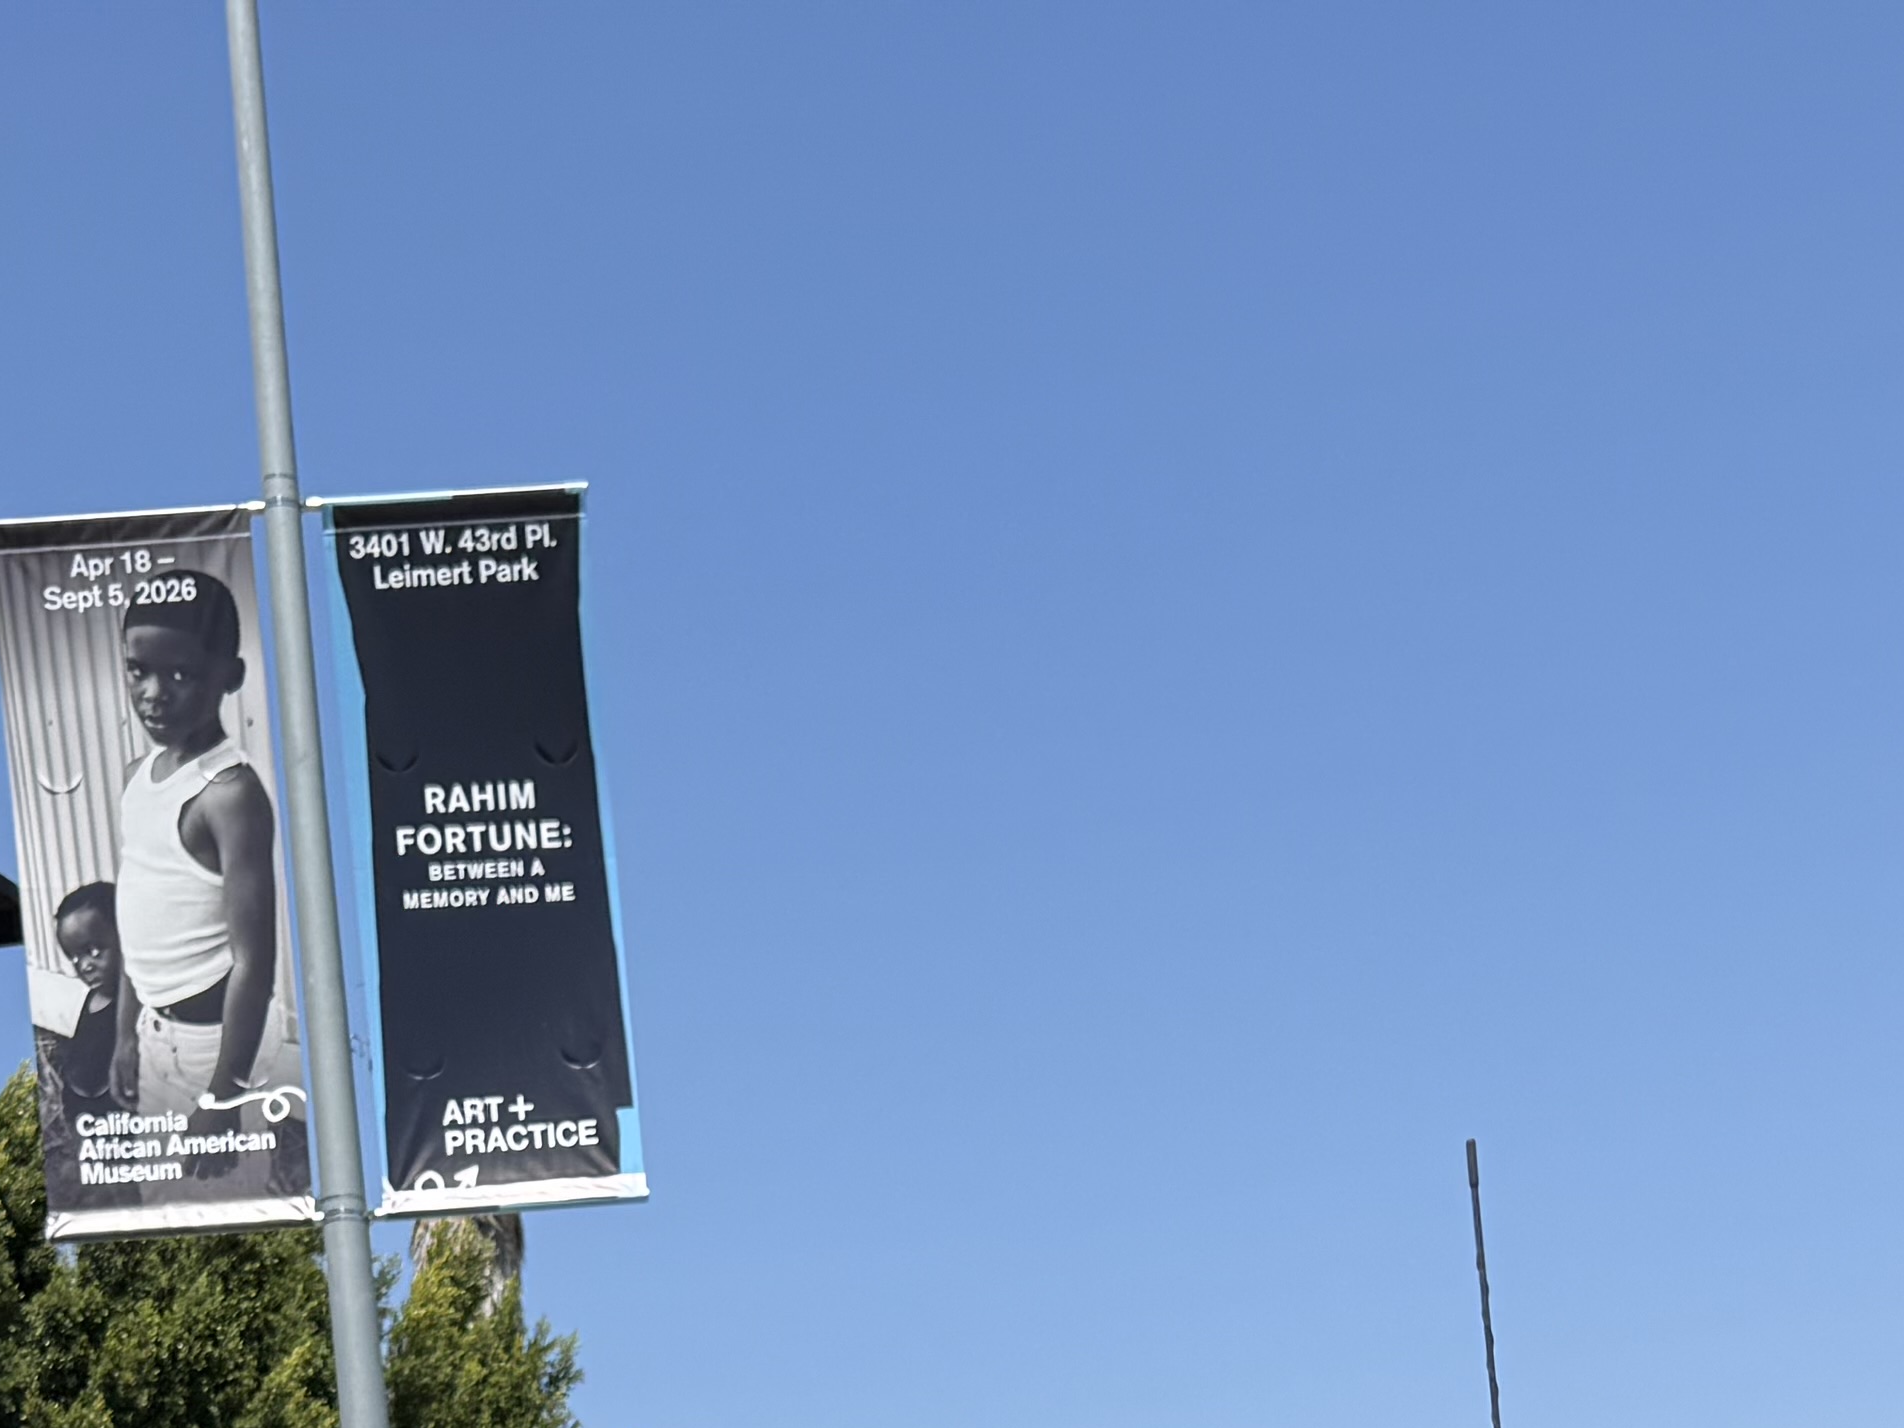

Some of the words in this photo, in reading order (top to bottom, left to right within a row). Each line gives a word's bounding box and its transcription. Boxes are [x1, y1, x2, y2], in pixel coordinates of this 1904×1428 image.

[349, 532, 409, 559] 3401
[419, 528, 451, 555] W.
[458, 524, 518, 552] 43rd
[524, 523, 557, 549] Pl.
[70, 553, 114, 581] Apr
[120, 549, 151, 574] 18
[373, 560, 473, 590] Leimert
[479, 555, 540, 584] Park
[43, 585, 104, 613] Sept
[108, 583, 131, 609] 5,
[135, 578, 197, 605] 2026
[424, 779, 536, 815] RAHIM
[396, 819, 573, 856] FORTUNE:
[428, 859, 524, 882] BETWEEN
[530, 857, 546, 877] A
[402, 887, 491, 910] MEMORY
[496, 885, 539, 905] AND
[544, 882, 576, 903] ME
[76, 1110, 188, 1137] California
[442, 1096, 504, 1126] ART
[79, 1138, 161, 1161] African
[167, 1129, 277, 1156] American
[445, 1119, 600, 1156] PRACTICE
[80, 1162, 183, 1185] Museum
